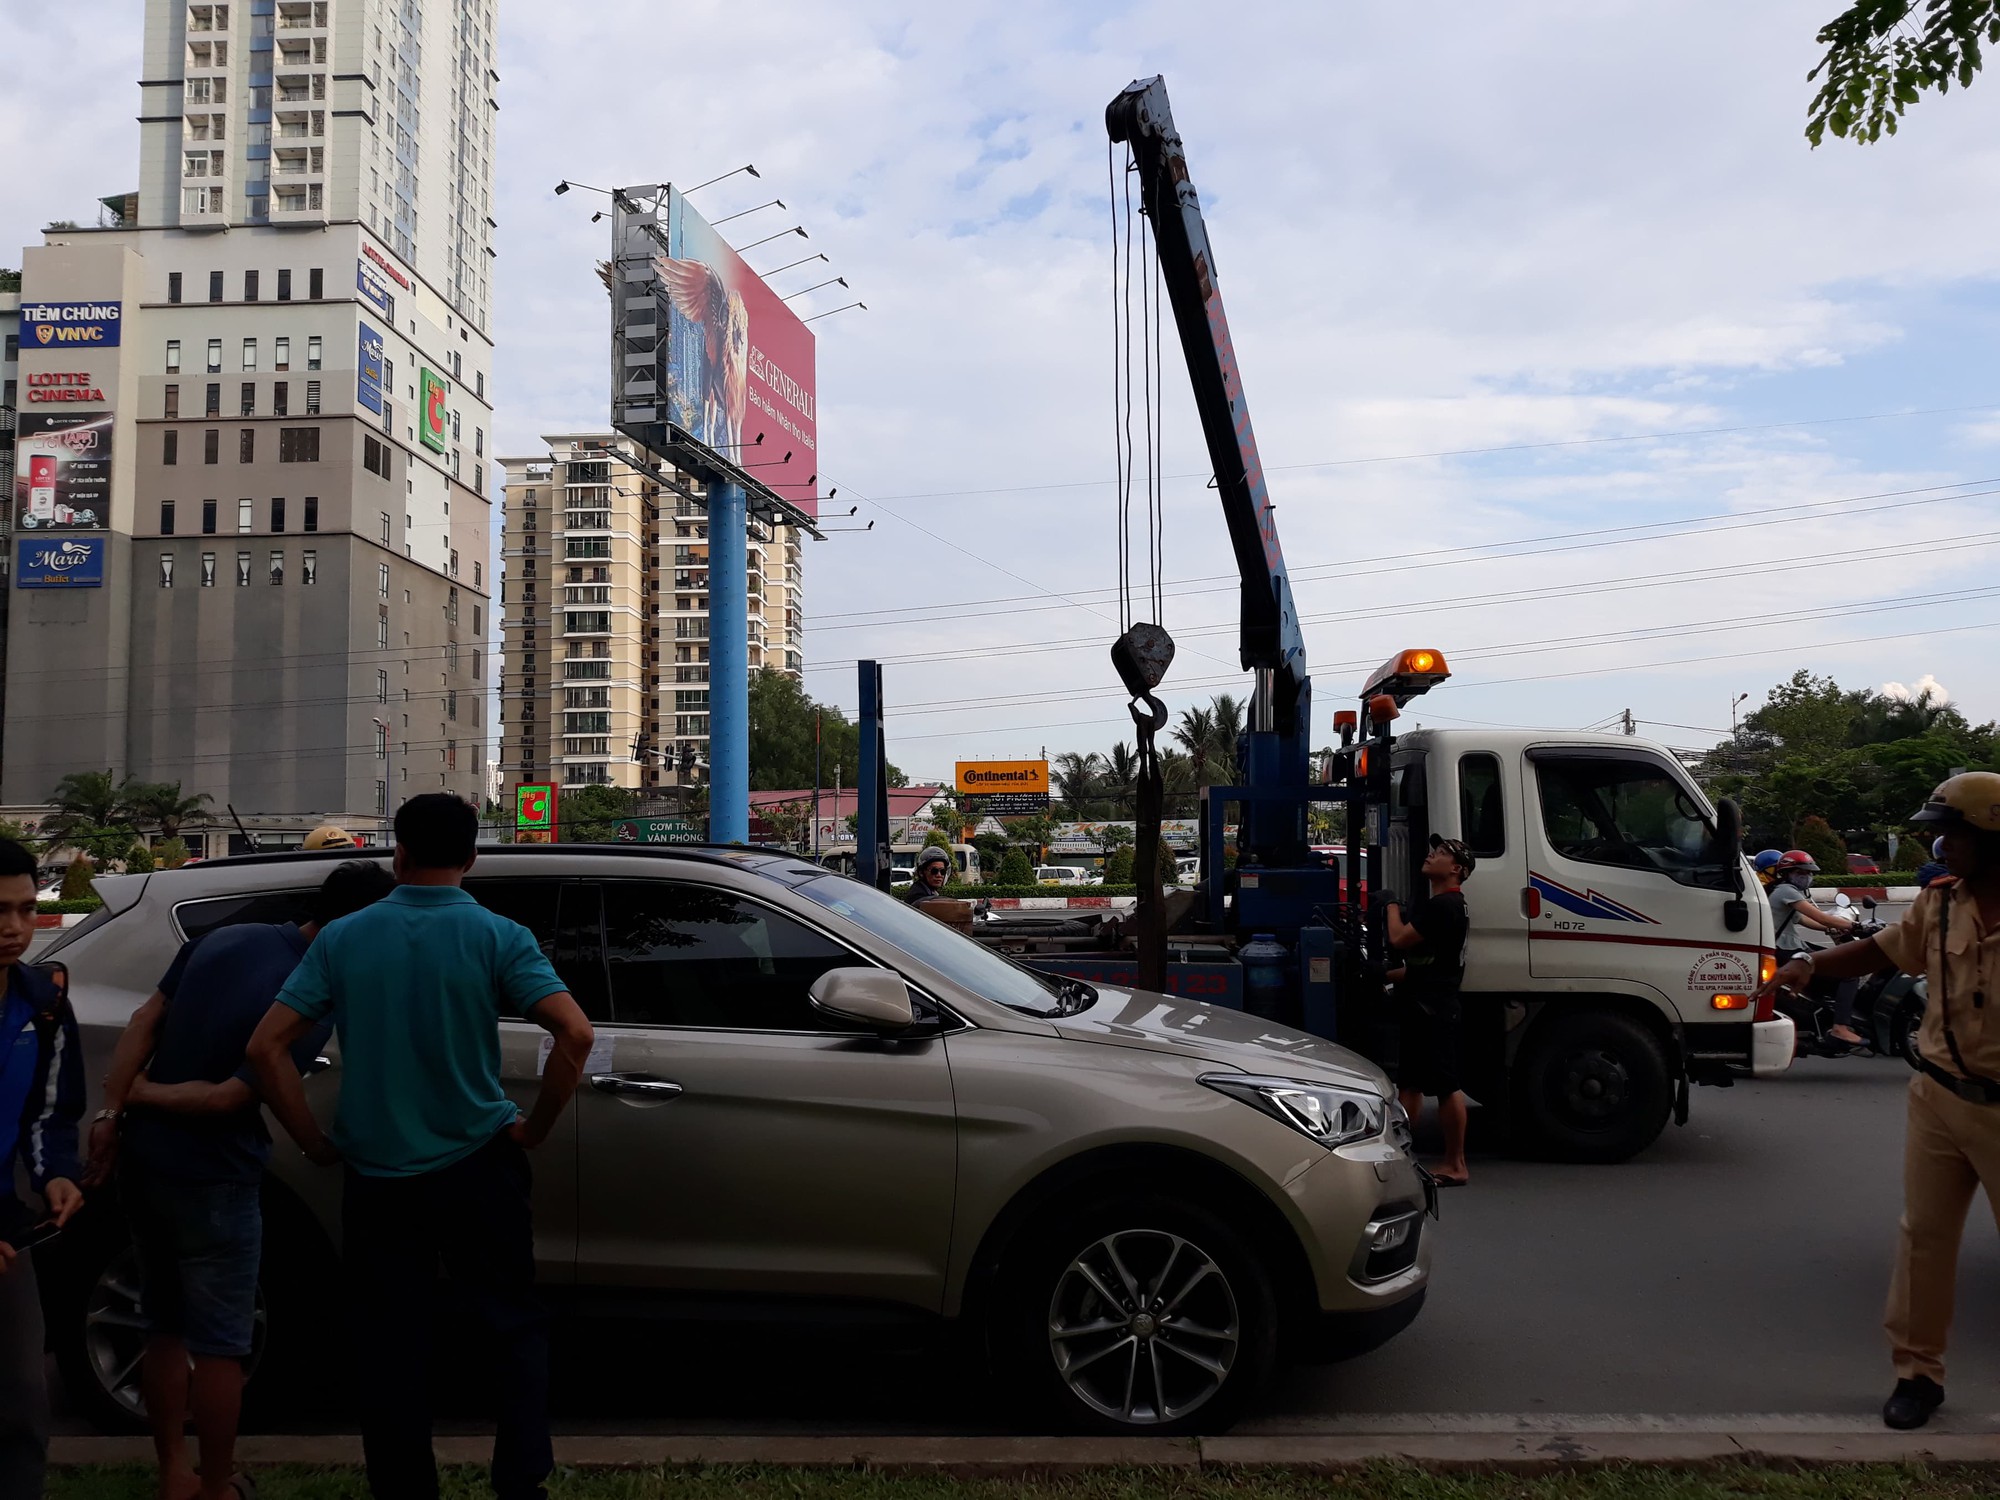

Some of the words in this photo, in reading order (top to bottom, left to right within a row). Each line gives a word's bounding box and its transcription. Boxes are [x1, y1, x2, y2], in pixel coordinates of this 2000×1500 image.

[22, 304, 60, 321] TIÊM
[56, 326, 104, 341] VNVC
[28, 373, 90, 386] LOTTE
[28, 389, 106, 402] CINEMA
[428, 380, 439, 400] Big
[766, 360, 814, 421] GENERALI
[964, 770, 1028, 784] Continental
[522, 792, 535, 800] Big
[647, 833, 667, 842] VĂN
[670, 832, 704, 842] PHÒNG
